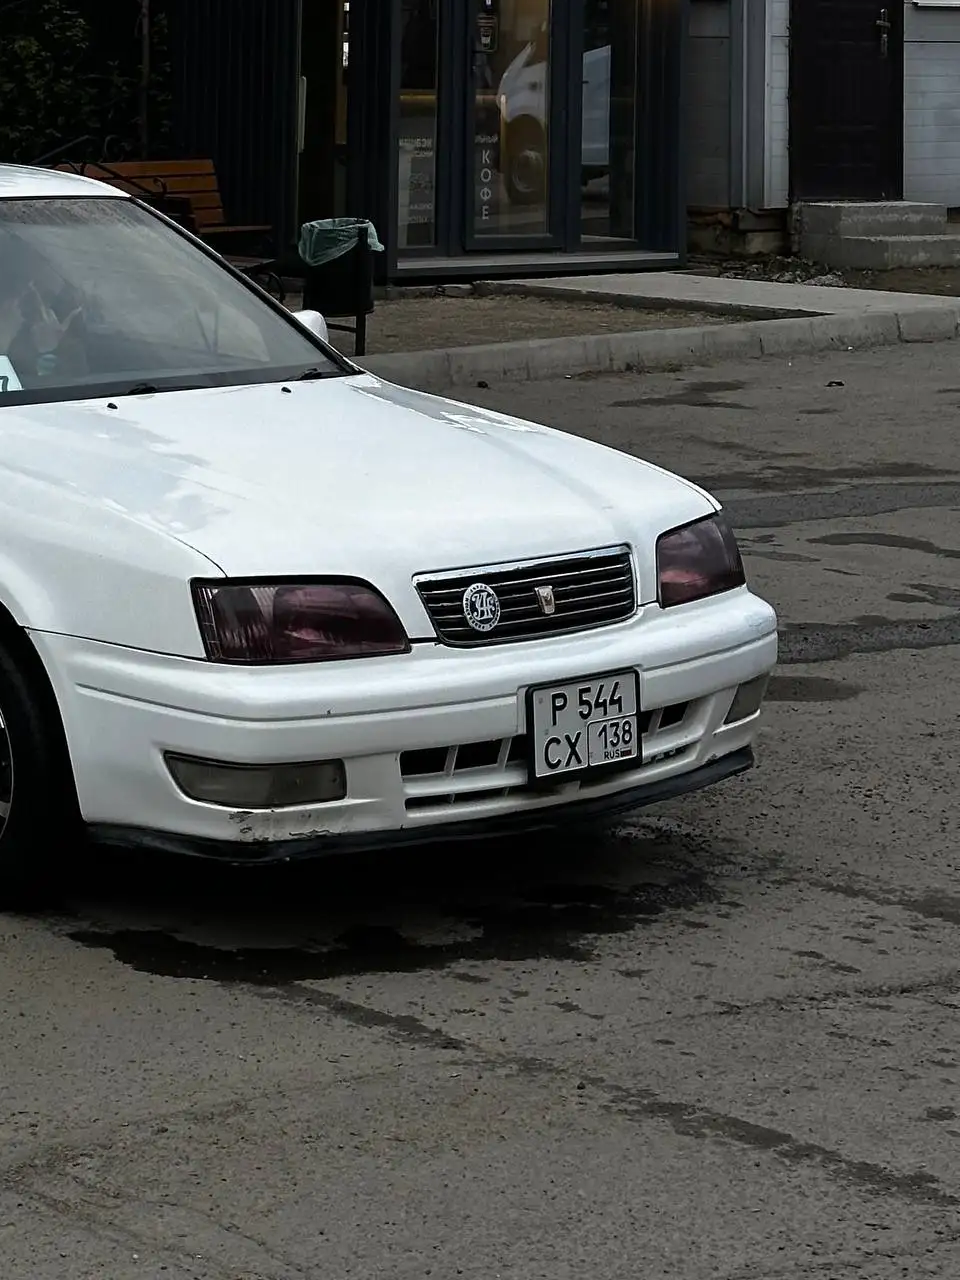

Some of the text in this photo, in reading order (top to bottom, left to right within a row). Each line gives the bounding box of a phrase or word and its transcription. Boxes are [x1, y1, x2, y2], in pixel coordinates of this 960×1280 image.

[480, 149, 492, 220] КОФЕ
[551, 681, 622, 726] Р 544
[544, 731, 582, 770] СХ
[597, 720, 633, 749] 138
[604, 749, 620, 760] RUS
